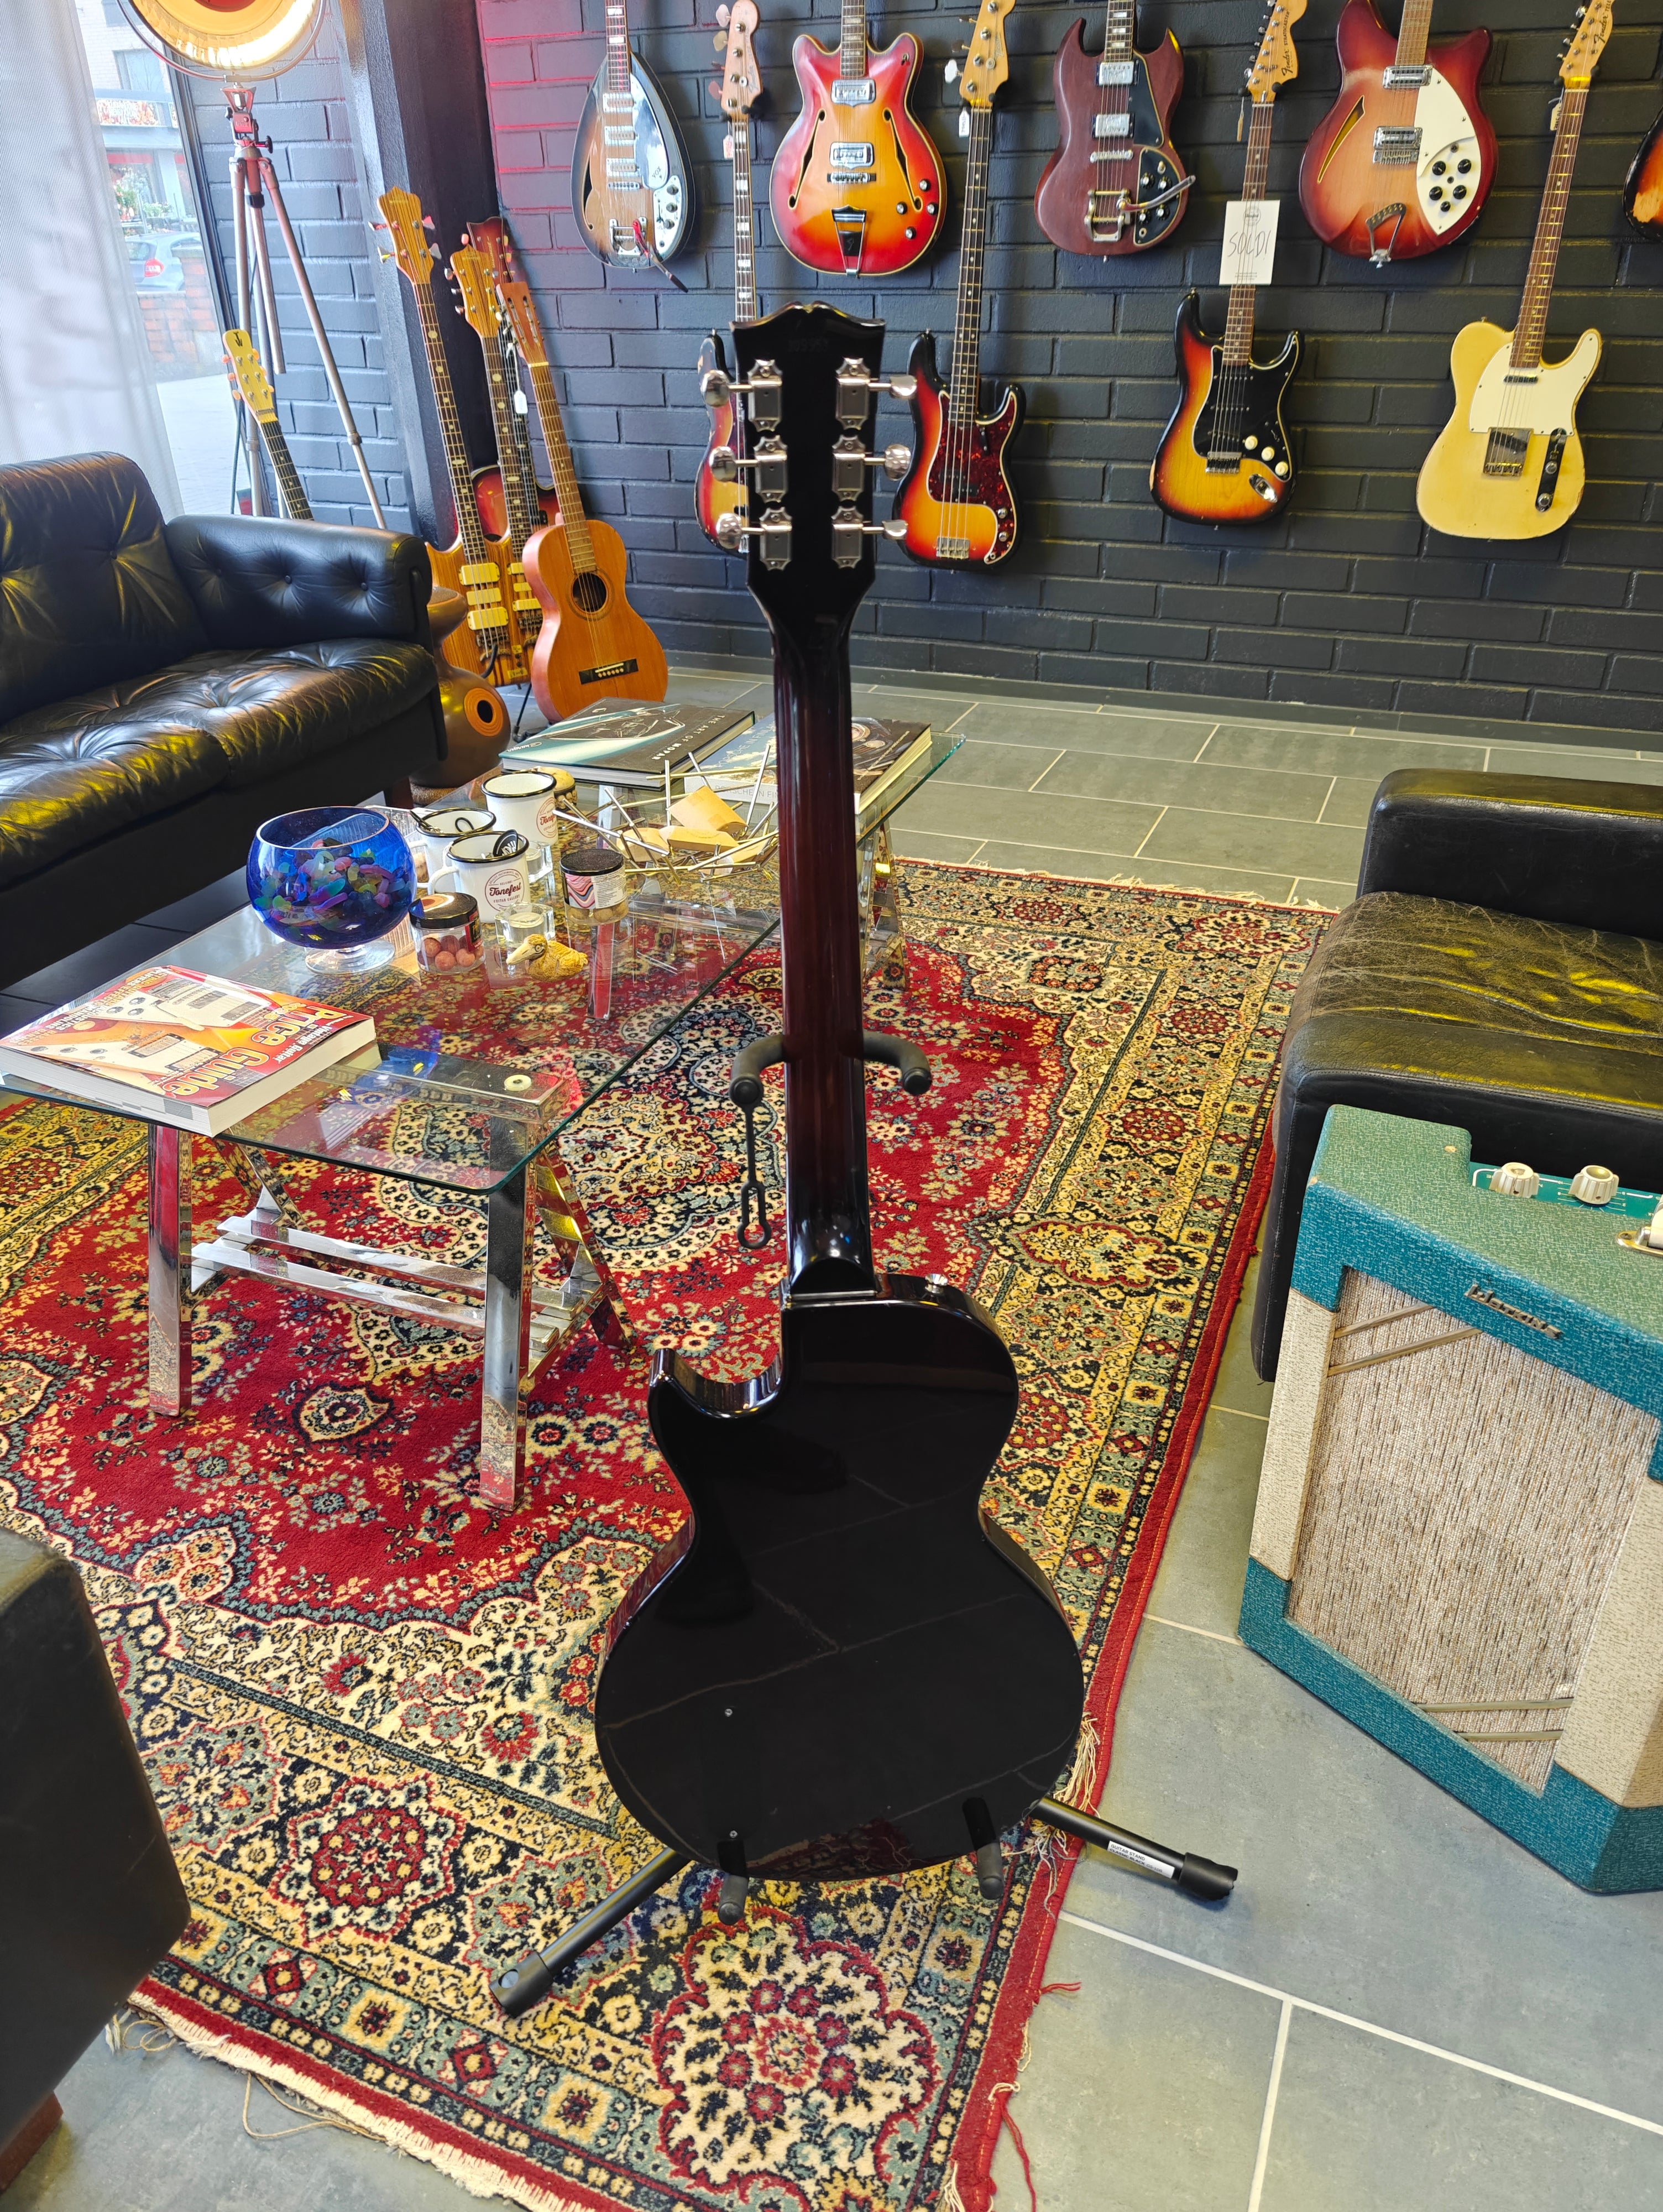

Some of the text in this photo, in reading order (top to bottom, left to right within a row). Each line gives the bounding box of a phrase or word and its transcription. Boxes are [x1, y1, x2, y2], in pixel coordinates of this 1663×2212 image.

[1594, 14, 1608, 44] Fender
[1282, 49, 1293, 76] Fender
[1227, 230, 1272, 260] SOLD!
[708, 715, 725, 724] THE
[693, 725, 709, 734] ART
[651, 743, 682, 760] MOPAR
[489, 882, 522, 896] Tonefest
[252, 1005, 347, 1046] Price
[296, 1025, 333, 1045] Vintage
[273, 1044, 304, 1063] Guitar
[162, 1047, 270, 1095] Guide
[1110, 1848, 1129, 1859] CLASSIC
[1129, 1857, 1146, 1866] BLACK
[1111, 1844, 1146, 1861] GUITAR STAND
